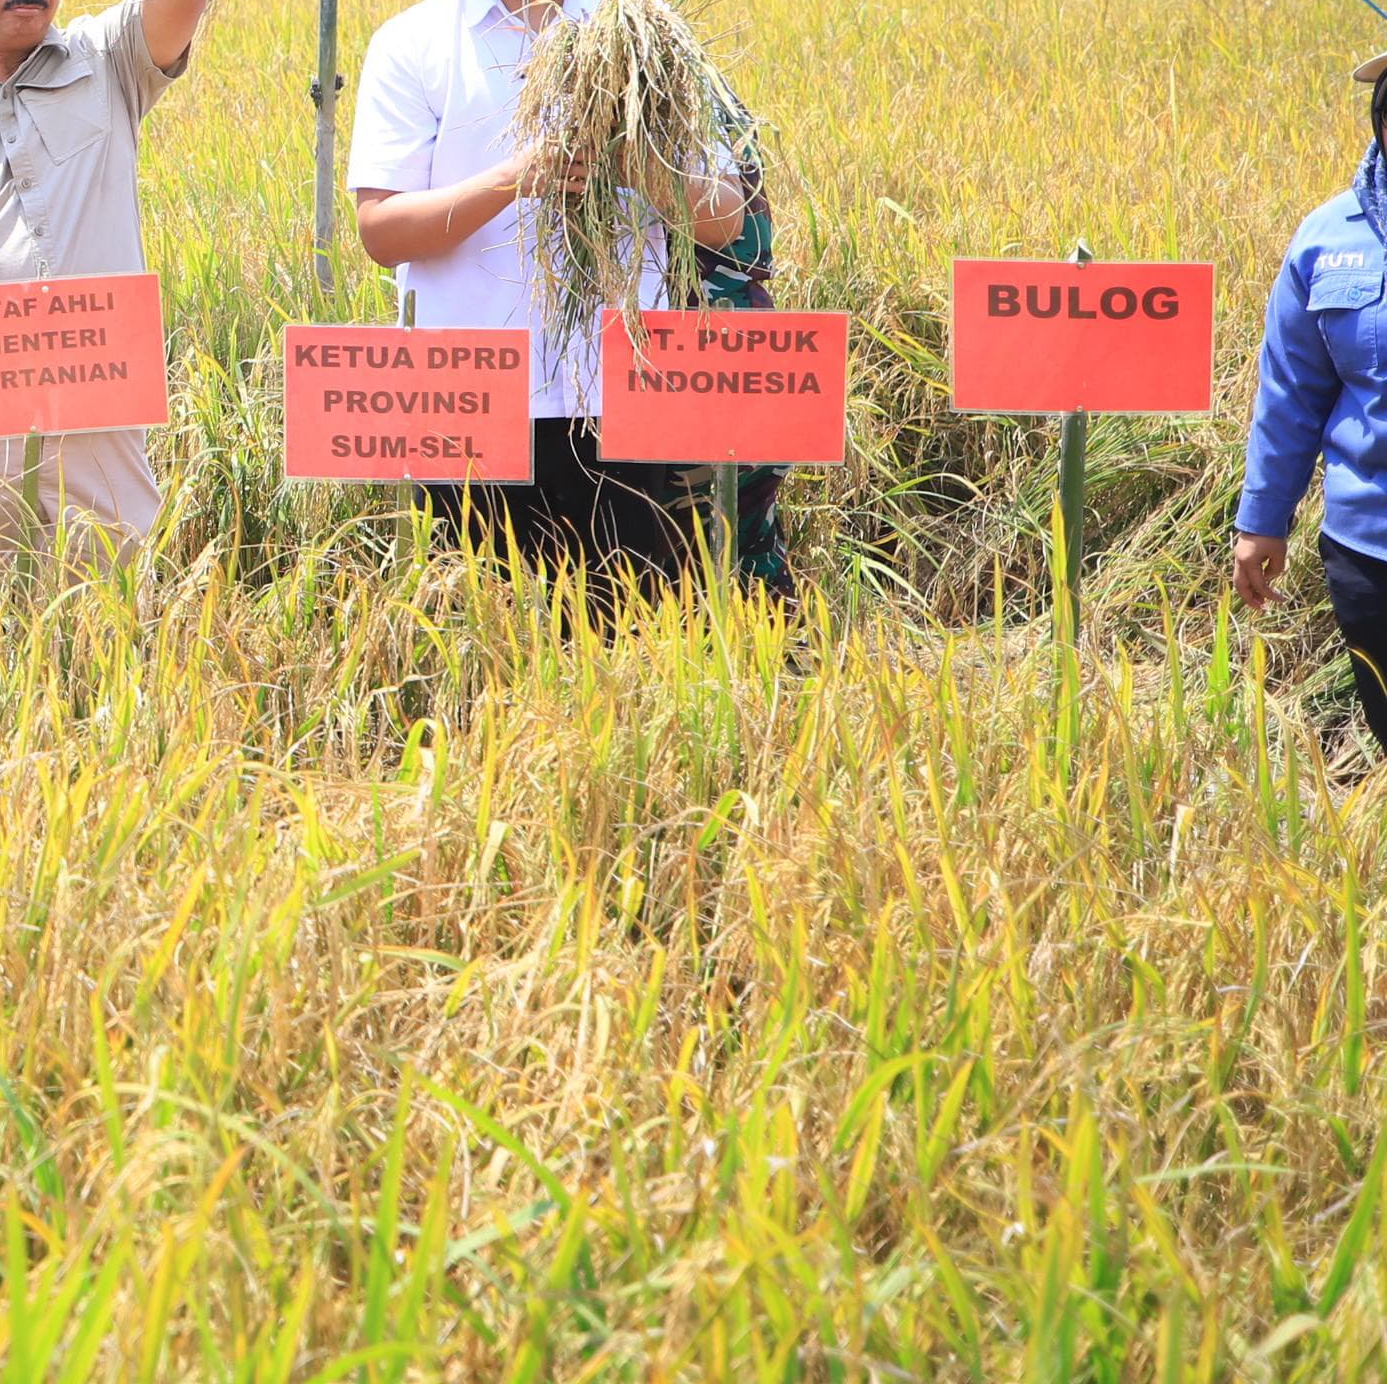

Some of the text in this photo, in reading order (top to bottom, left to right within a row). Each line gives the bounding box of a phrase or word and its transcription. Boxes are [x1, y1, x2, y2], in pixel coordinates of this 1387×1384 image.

[47, 292, 115, 315] AHLI
[987, 283, 1179, 320] BULOG
[631, 328, 819, 353] T. PUPUK
[295, 344, 521, 370] KETUA DPRD
[627, 370, 821, 394] INDONESIA
[323, 389, 490, 414] PROVINSI
[331, 434, 484, 459] SUM-SEL
